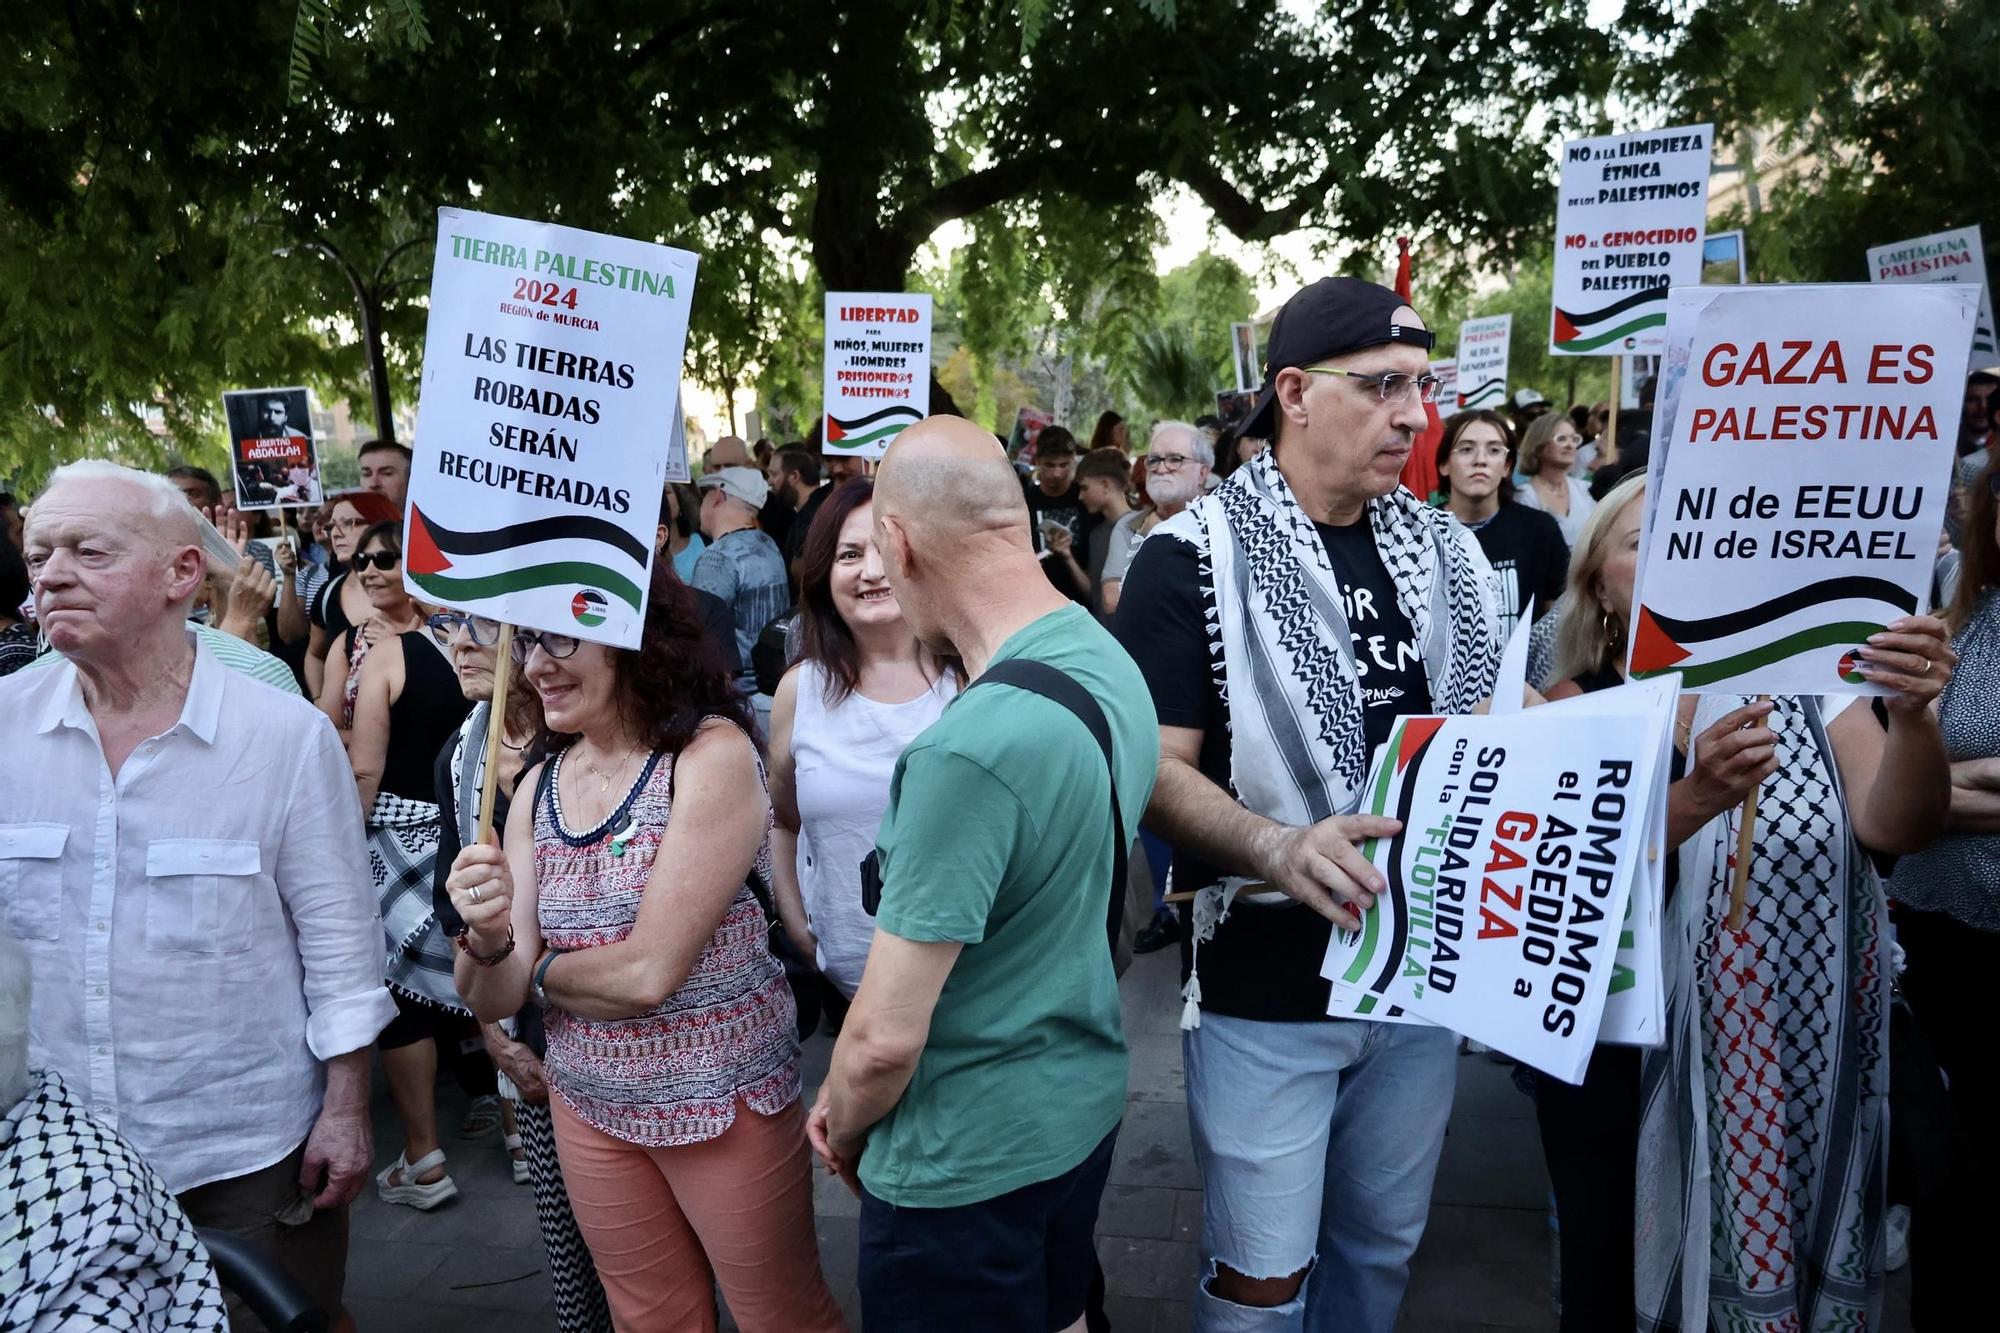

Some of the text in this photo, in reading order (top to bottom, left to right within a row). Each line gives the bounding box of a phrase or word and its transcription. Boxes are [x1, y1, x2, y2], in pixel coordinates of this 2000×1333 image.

[1569, 135, 1703, 163] NO A LA LIMPIEZA
[1602, 162, 1661, 181] ÉTNICA
[1568, 181, 1700, 207] DE LOS PALESTINOS
[1565, 234, 1586, 250] NO
[1602, 227, 1697, 247] GENOCIDIO
[1878, 237, 1968, 266] CARTAGENA
[451, 235, 675, 299] TIERRA PALESTINA
[1581, 251, 1671, 270] DEL PUEBLO
[1880, 250, 1972, 280] PALESTINA
[513, 277, 578, 311] 2024
[1582, 274, 1671, 291] PALESTINO
[500, 301, 600, 332] REGIÓN de MURCIA
[840, 307, 920, 323] LIBERTAD
[834, 338, 924, 353] NIÑOS, MUJERES
[465, 333, 634, 389] LAS TIERRAS
[850, 356, 906, 368] HOMBRES
[1702, 340, 1935, 388] GAZA ES
[837, 371, 913, 384] PRISIONER@S
[842, 386, 910, 399] PALESTIN@S
[474, 376, 600, 425] ROBADAS
[1689, 405, 1938, 443] PALESTINA
[248, 446, 301, 459] ABDALLAH
[256, 438, 291, 448] LIBERTAD
[489, 422, 578, 463] SERÁN
[439, 451, 630, 514] RECUPERADAS
[1675, 485, 1924, 521] NI de EEUU
[1667, 529, 1917, 561] NI de ISRAEL
[1493, 560, 1516, 569] IBRE
[1448, 737, 1468, 775] con
[1438, 785, 1460, 804] la
[1428, 746, 1506, 994] SOLIDARIDAD
[1477, 810, 1538, 940] GAZA
[1513, 770, 1581, 999] el ASEDIO a
[1542, 759, 1633, 1039] ROMPAMOS
